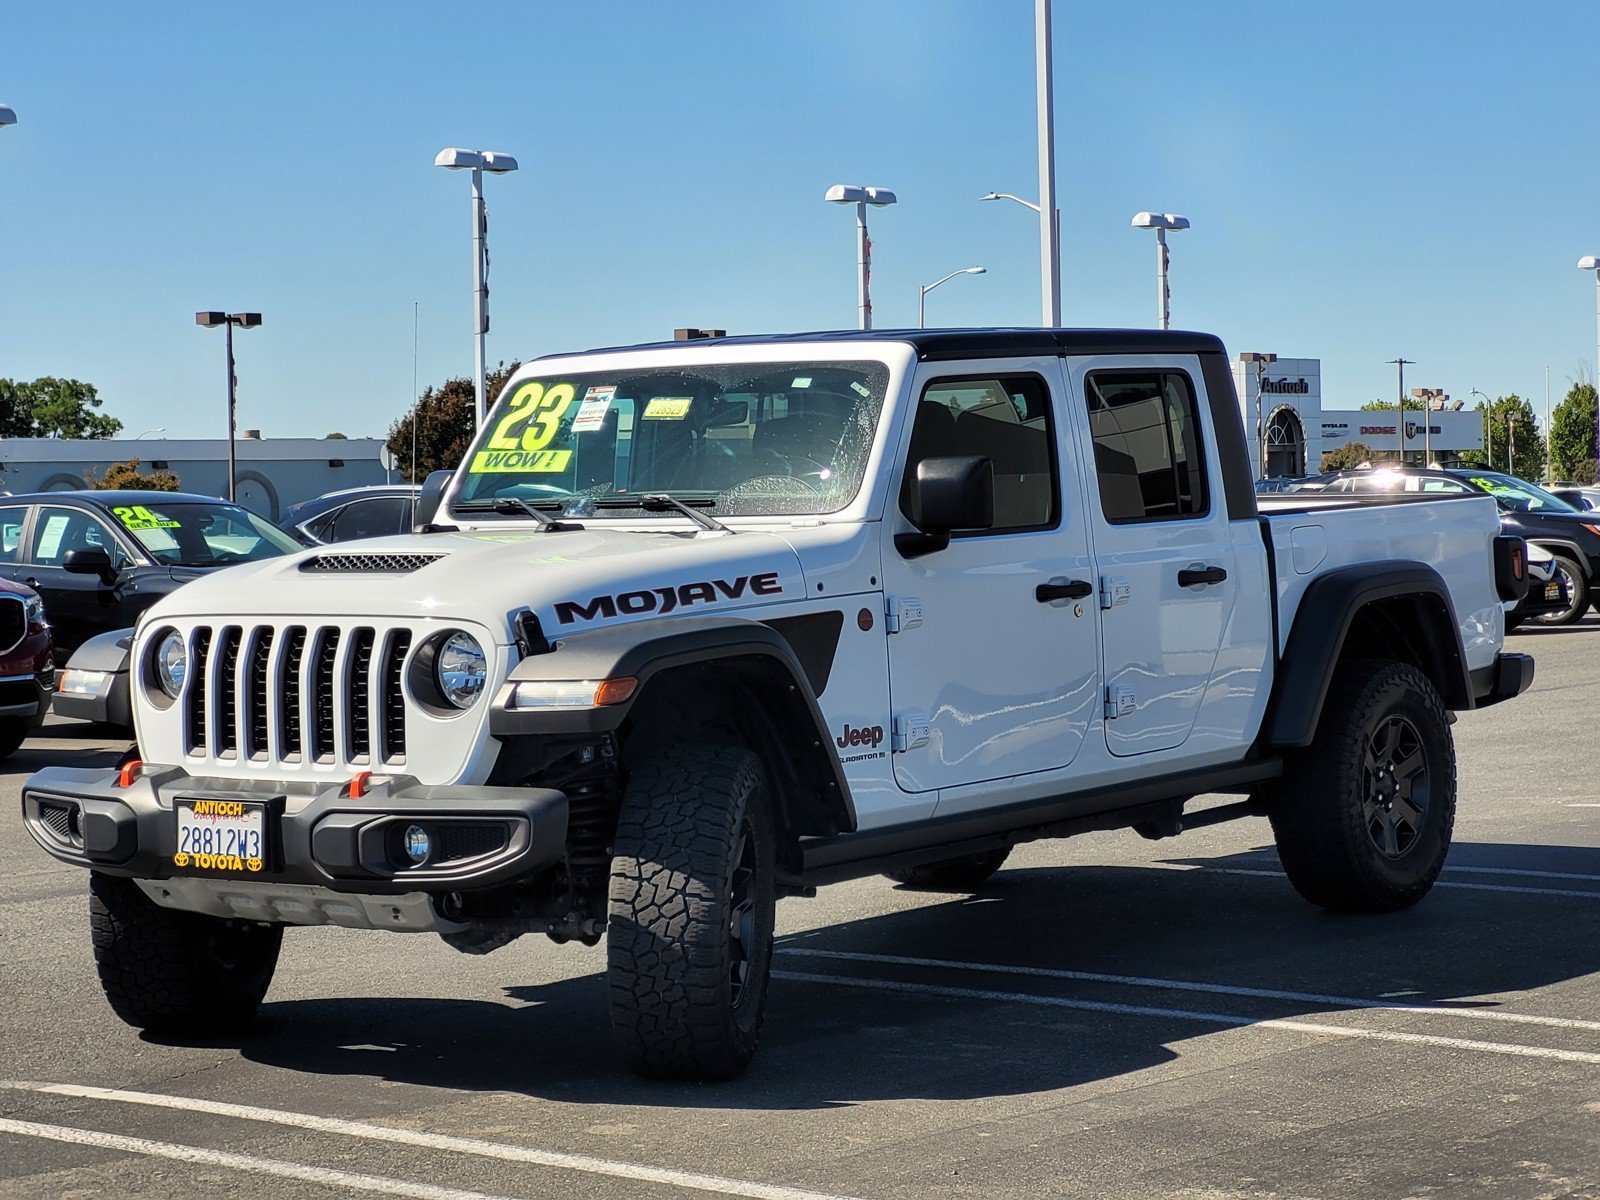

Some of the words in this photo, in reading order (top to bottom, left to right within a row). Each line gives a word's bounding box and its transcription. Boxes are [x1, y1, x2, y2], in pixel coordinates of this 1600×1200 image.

[1261, 377, 1309, 394] Antioch
[487, 382, 575, 450] 23
[1360, 426, 1397, 435] DODGE
[113, 506, 157, 524] 24
[553, 571, 783, 625] MOJAVE
[836, 724, 884, 749] Jeep
[194, 801, 242, 816] ANTIOCH
[181, 826, 259, 858] 28812W3
[194, 854, 243, 871] TOYOTA
